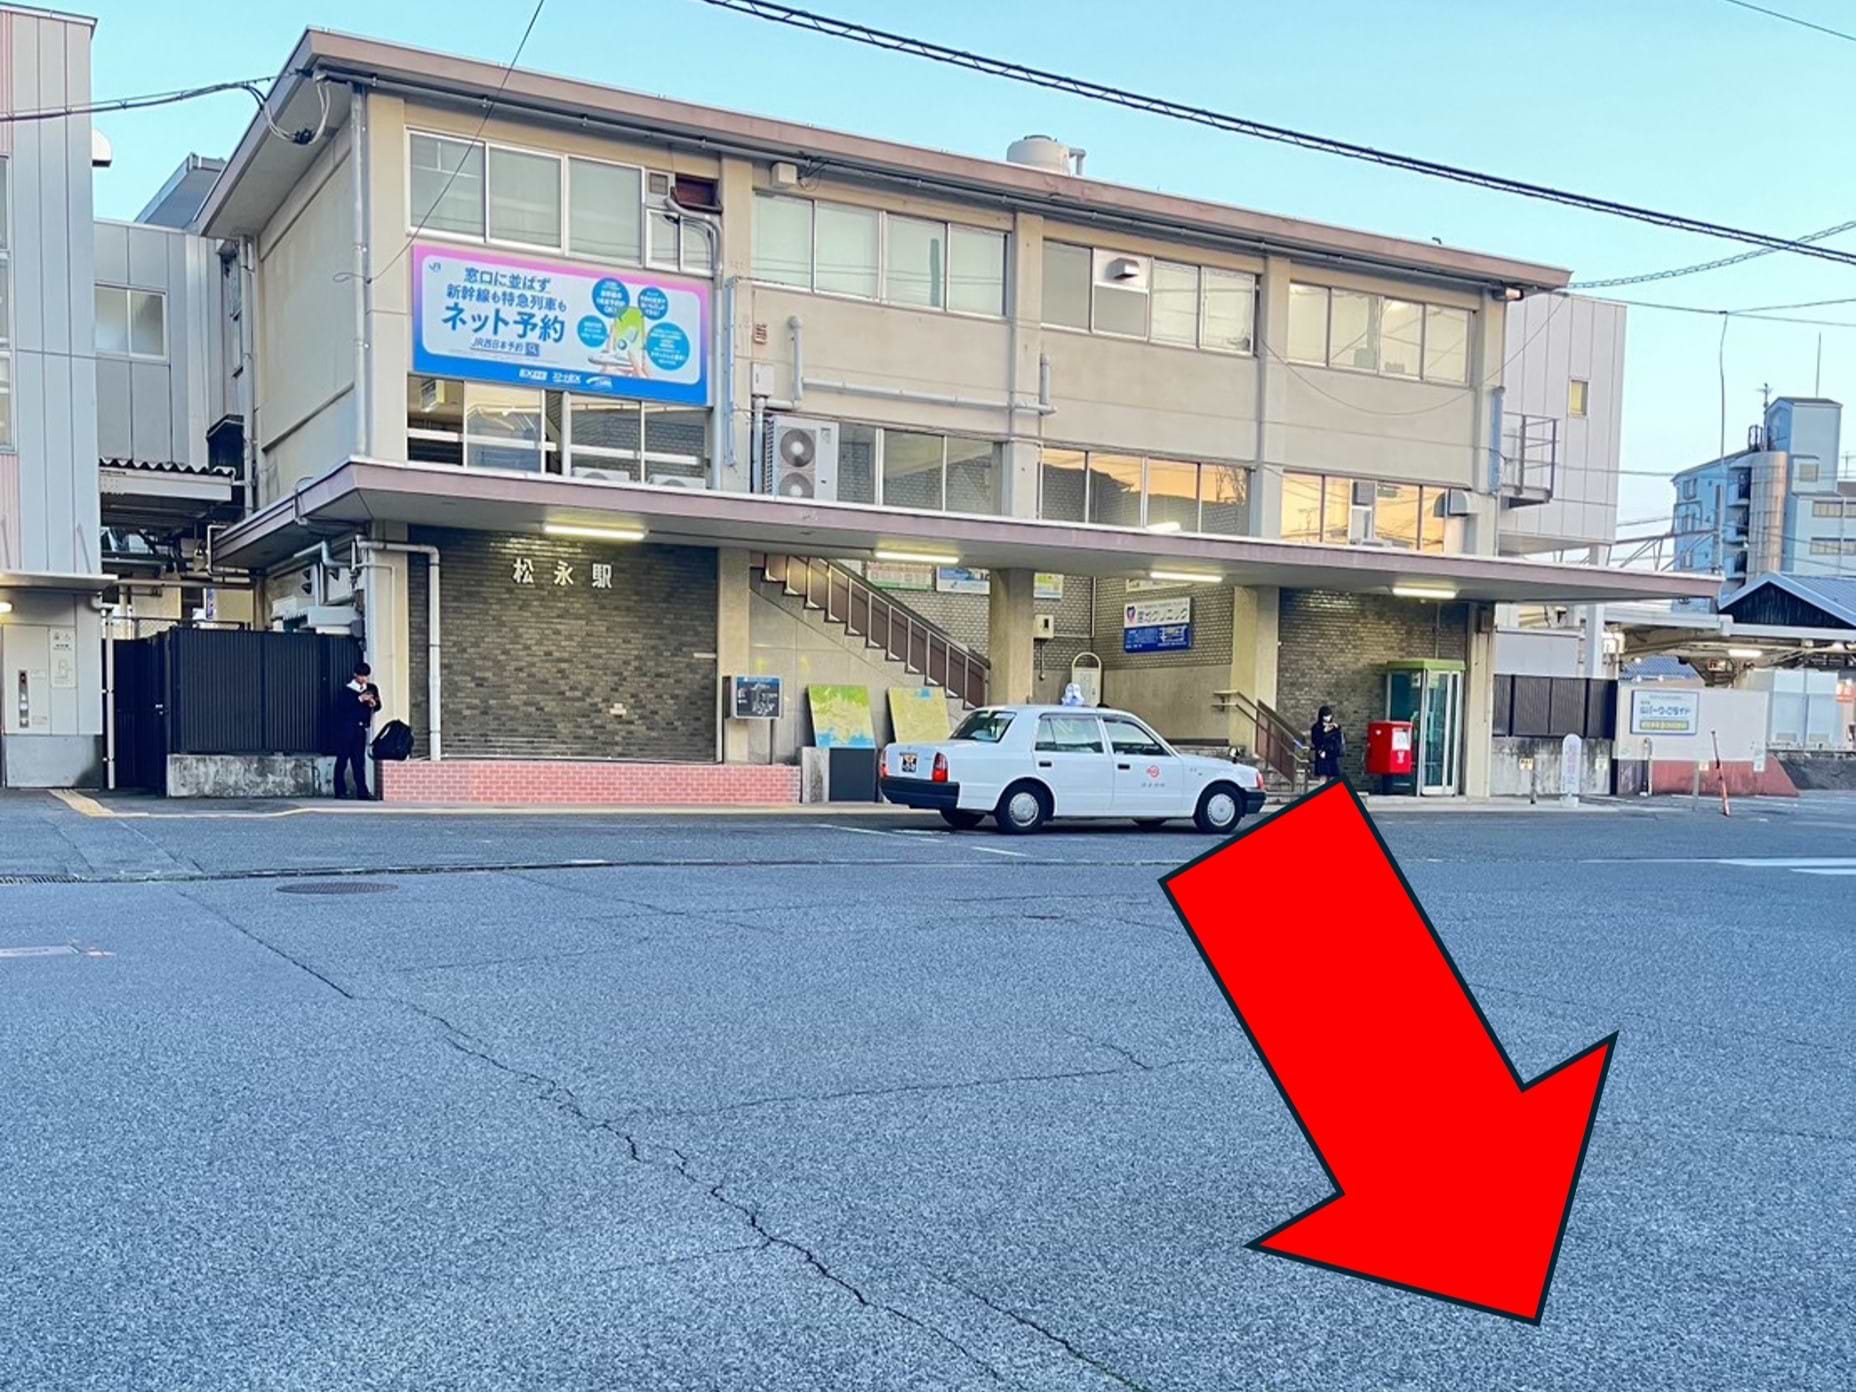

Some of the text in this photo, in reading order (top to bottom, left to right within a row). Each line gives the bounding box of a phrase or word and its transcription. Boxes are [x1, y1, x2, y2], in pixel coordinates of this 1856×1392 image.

[464, 267, 551, 292] 窓口に並ばず
[446, 284, 567, 313] 新幹線も特急列車も
[442, 302, 565, 343] ネット予約
[471, 337, 525, 352] JR西日本予約
[513, 557, 612, 589] 松永駅
